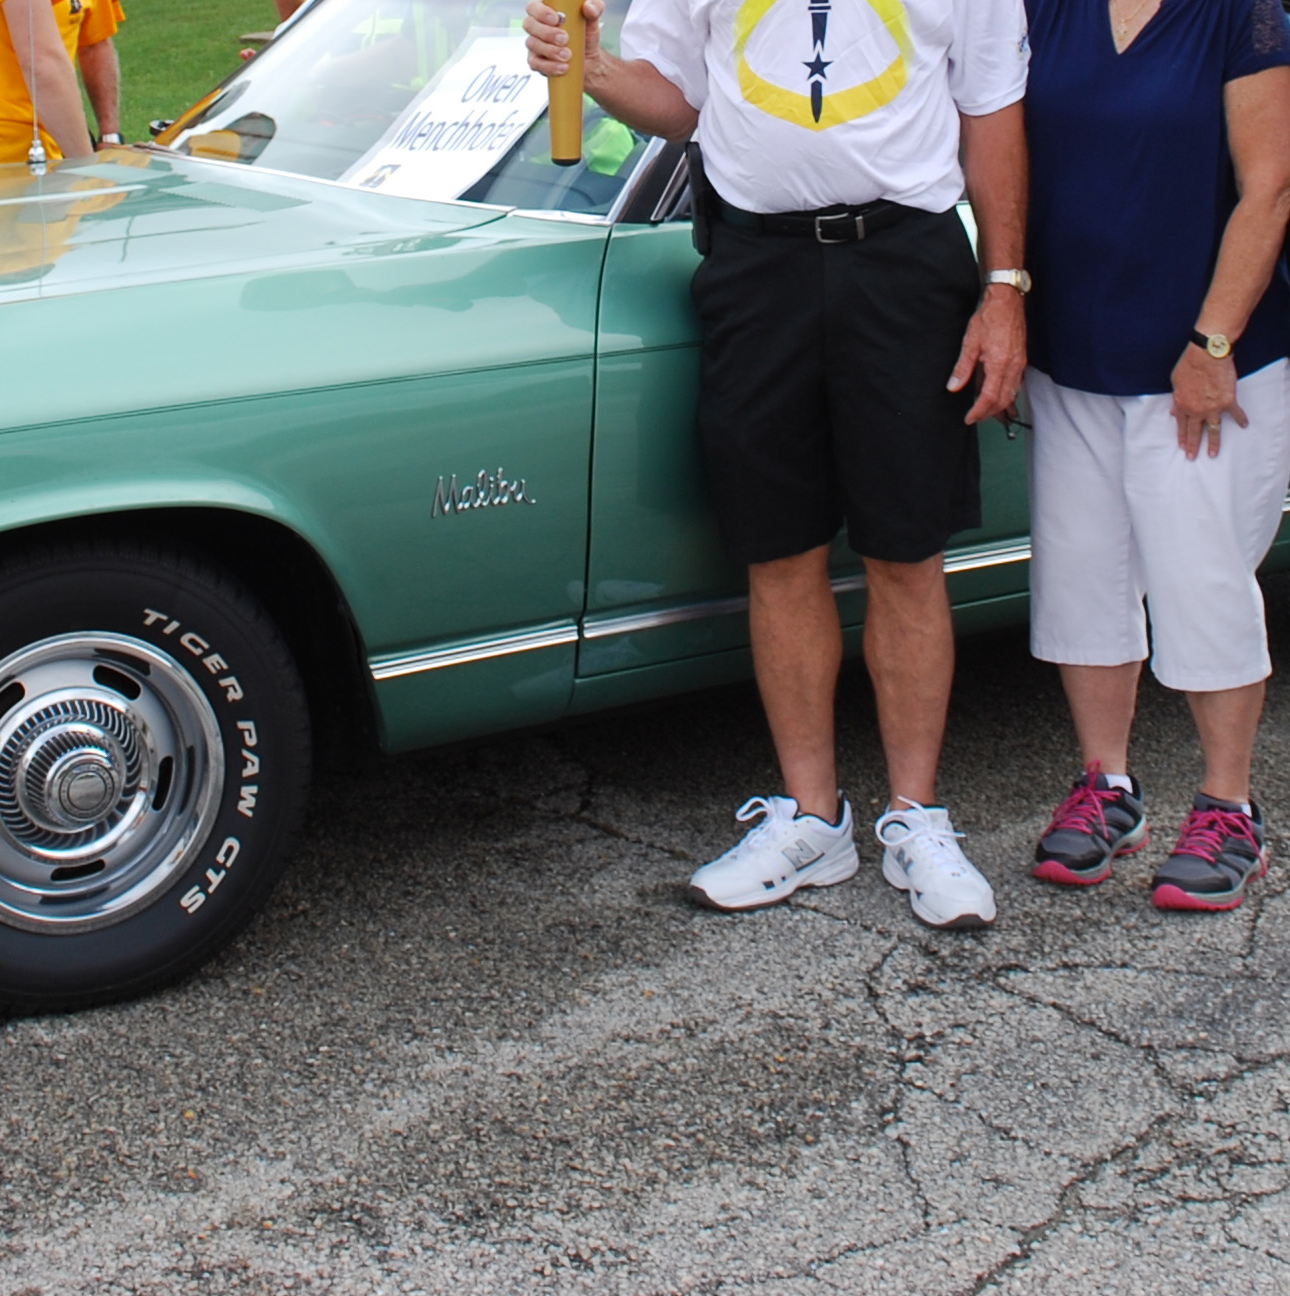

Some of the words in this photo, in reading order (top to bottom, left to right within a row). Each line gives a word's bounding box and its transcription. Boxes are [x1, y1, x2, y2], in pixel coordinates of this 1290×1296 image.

[461, 65, 531, 103] Owen
[391, 109, 525, 151] Menchhofer
[431, 466, 537, 518] Malibu
[143, 608, 244, 703] TIGER
[236, 720, 260, 818] PAW
[179, 836, 241, 914] GTS
